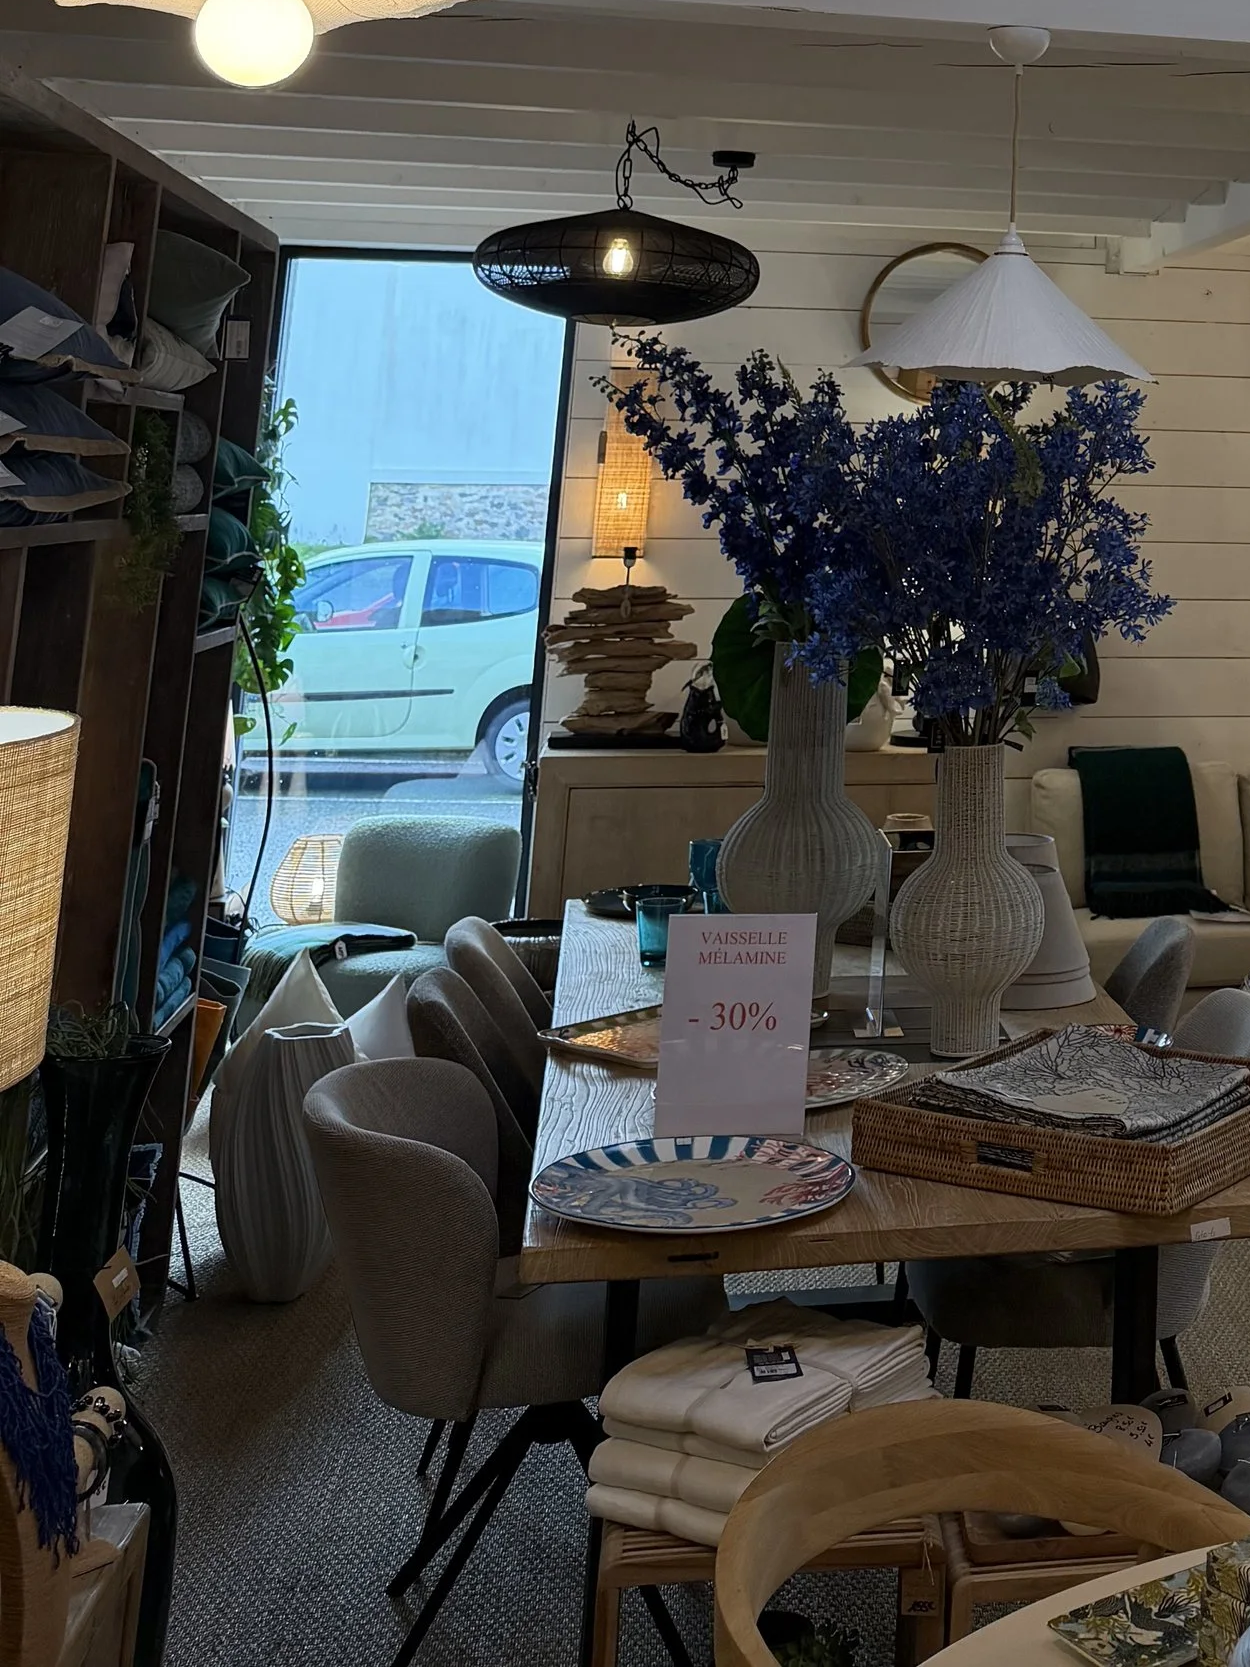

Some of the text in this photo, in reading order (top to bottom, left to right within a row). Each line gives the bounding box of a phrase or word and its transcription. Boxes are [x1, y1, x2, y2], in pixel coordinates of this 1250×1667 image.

[701, 931, 788, 945] VAISSELLE
[698, 947, 787, 965] MÉLAMINE
[709, 1001, 777, 1031] 30%
